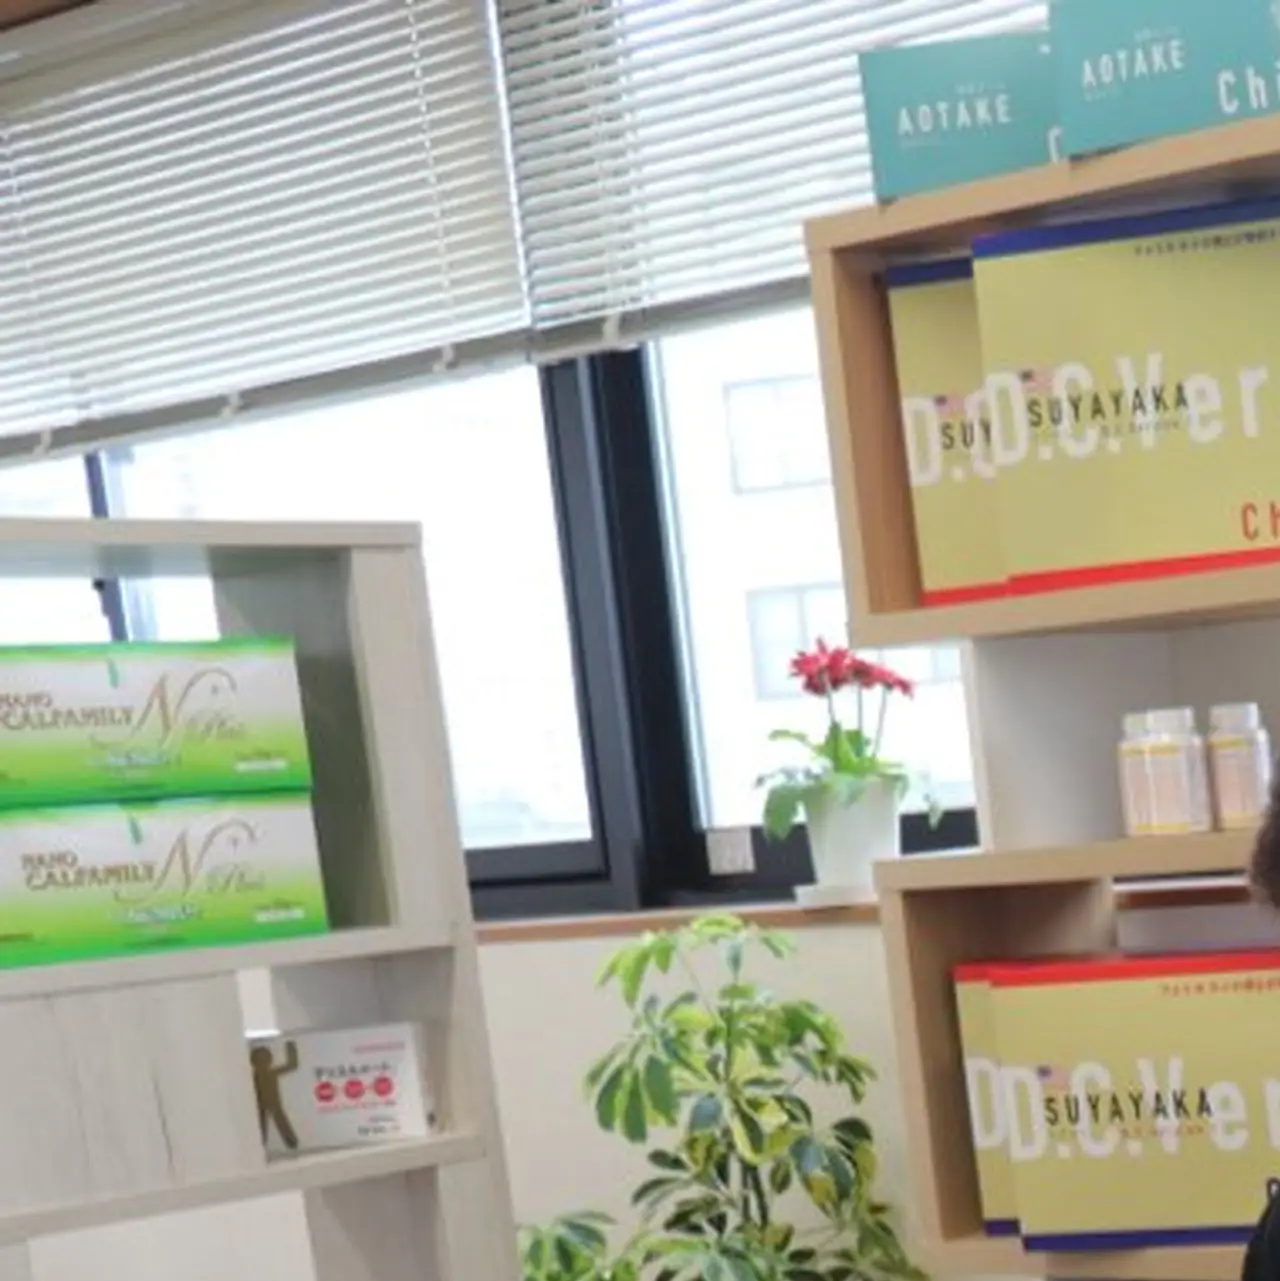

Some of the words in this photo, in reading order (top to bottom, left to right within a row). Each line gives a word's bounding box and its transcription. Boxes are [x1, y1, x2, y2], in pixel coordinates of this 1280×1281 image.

[1082, 38, 1186, 88] AOTAKE
[898, 94, 1012, 137] AOTAKE
[1028, 380, 1190, 429] SUYAYAKA
[1045, 1087, 1214, 1126] SUYAYAKA
